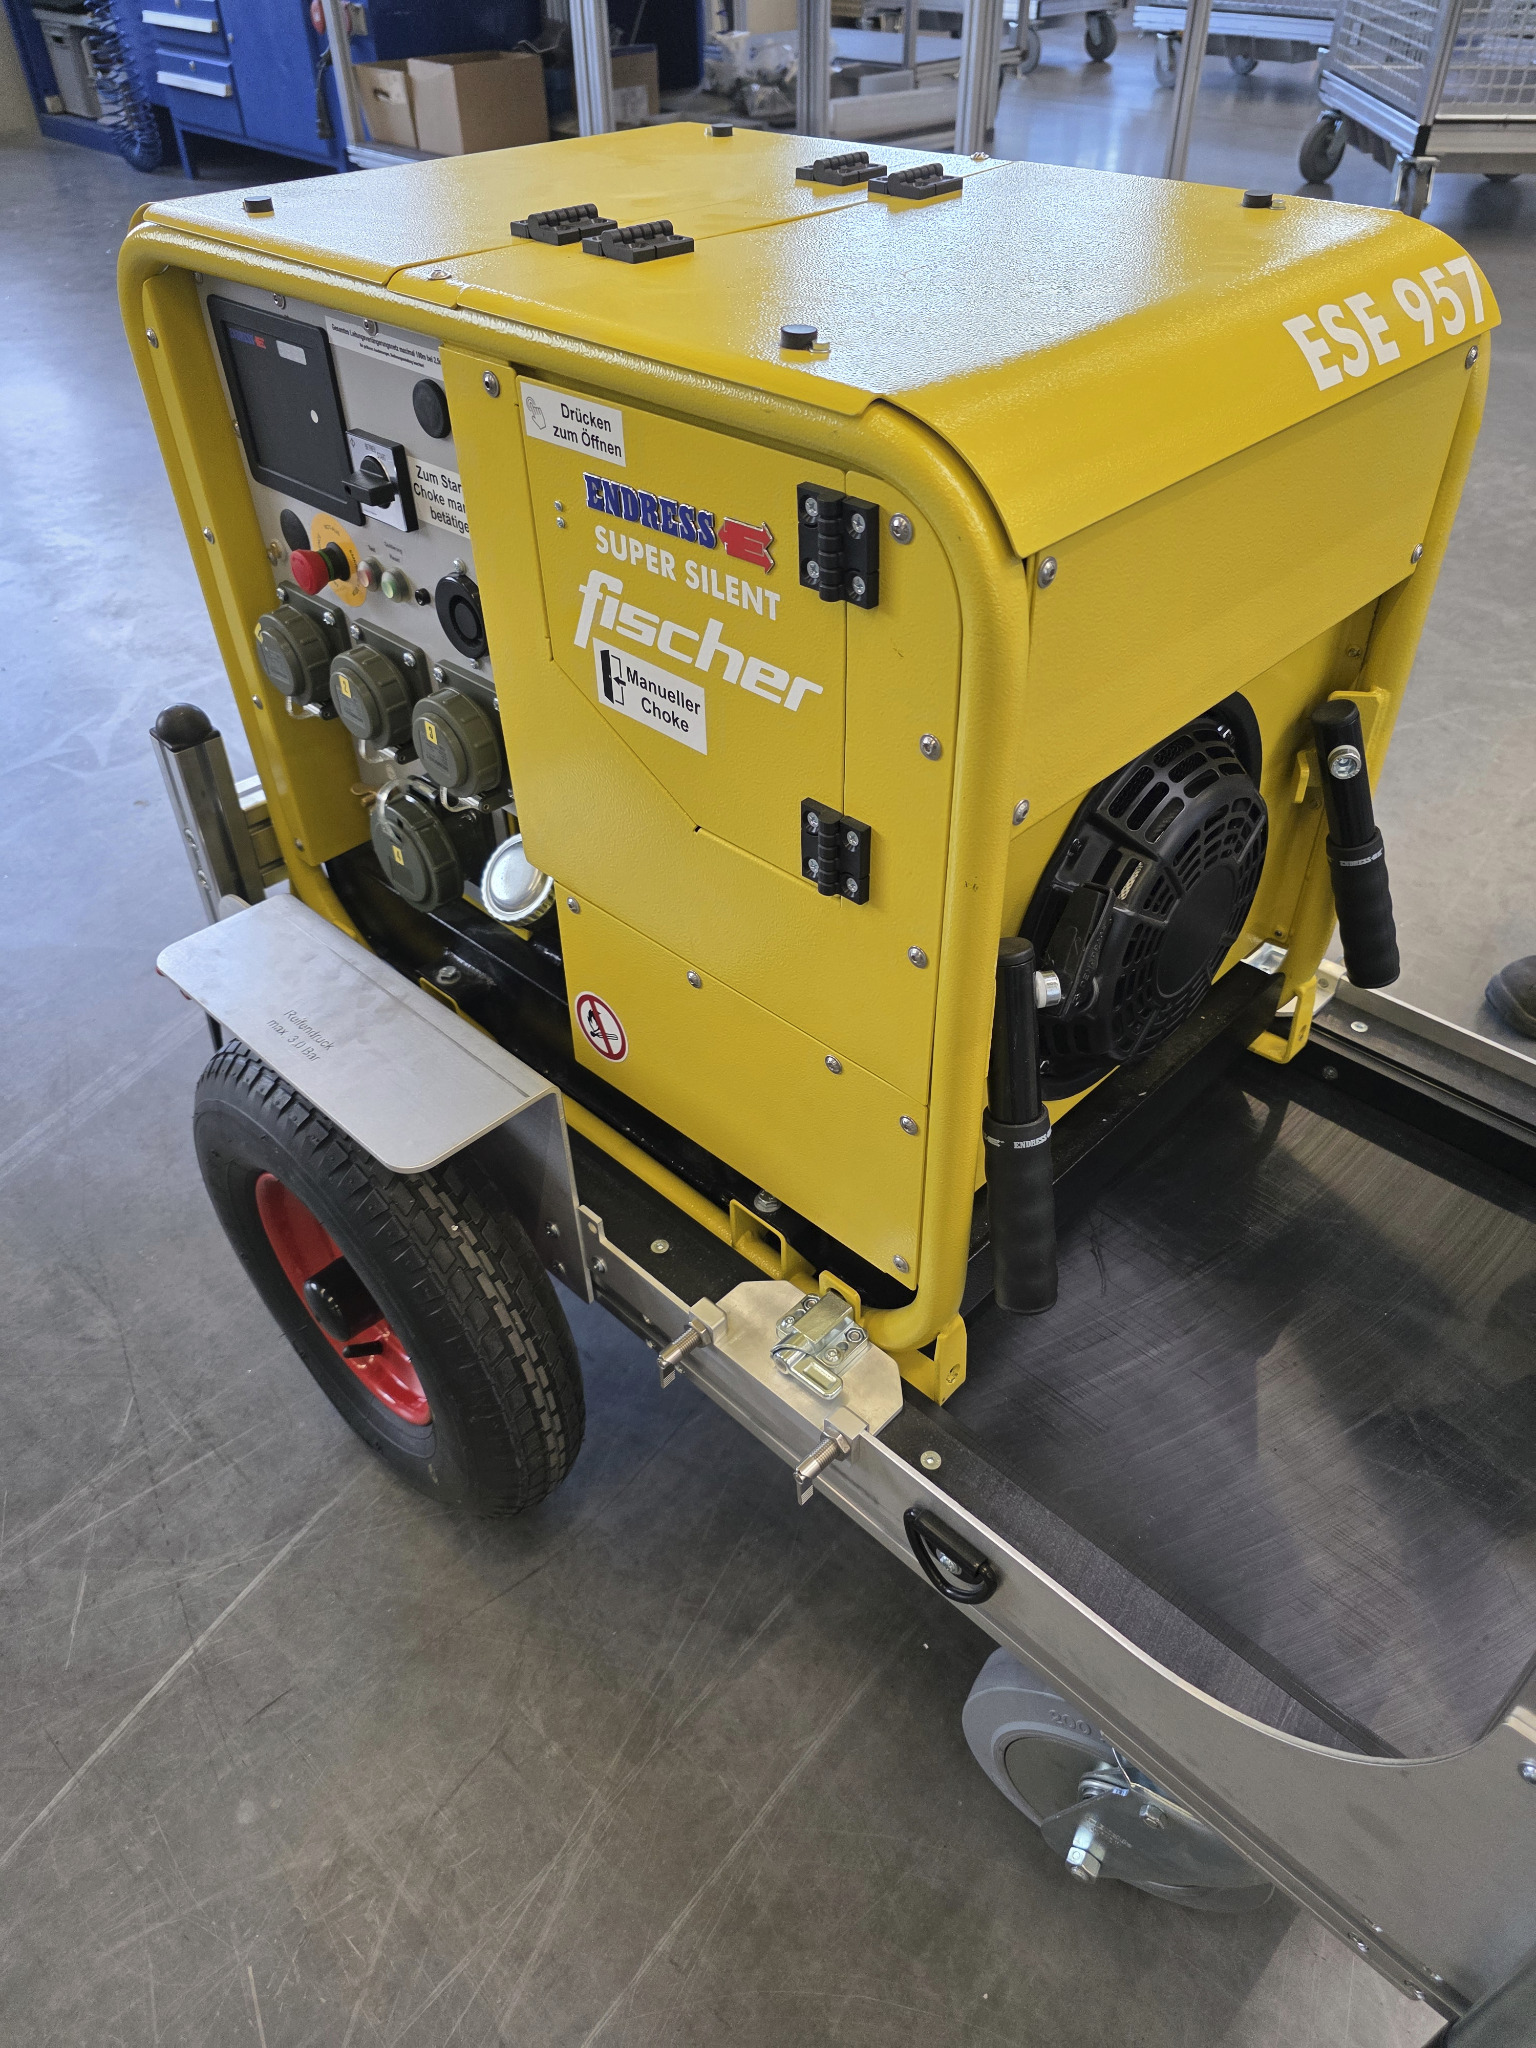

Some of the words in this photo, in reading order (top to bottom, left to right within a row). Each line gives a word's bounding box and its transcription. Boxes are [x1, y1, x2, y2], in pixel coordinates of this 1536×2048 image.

[1282, 291, 1400, 391] ESE
[1392, 255, 1484, 346] 957
[561, 402, 611, 432] Drücken
[552, 425, 578, 443] zum
[581, 427, 622, 457] Öffnen
[413, 482, 445, 505] Choke
[415, 464, 439, 485] Zum
[440, 474, 462, 493] Star
[429, 505, 470, 533] betätige
[583, 472, 717, 549] ENDRESS
[594, 525, 677, 581] SUPER
[685, 559, 780, 621] SILENT
[574, 569, 823, 712] fischer
[626, 665, 701, 715] Manueller
[641, 696, 690, 732] Choke
[301, 1046, 321, 1062] Bar
[1013, 1133, 1048, 1149] ENDRESS
[1049, 1709, 1092, 1736] 200
